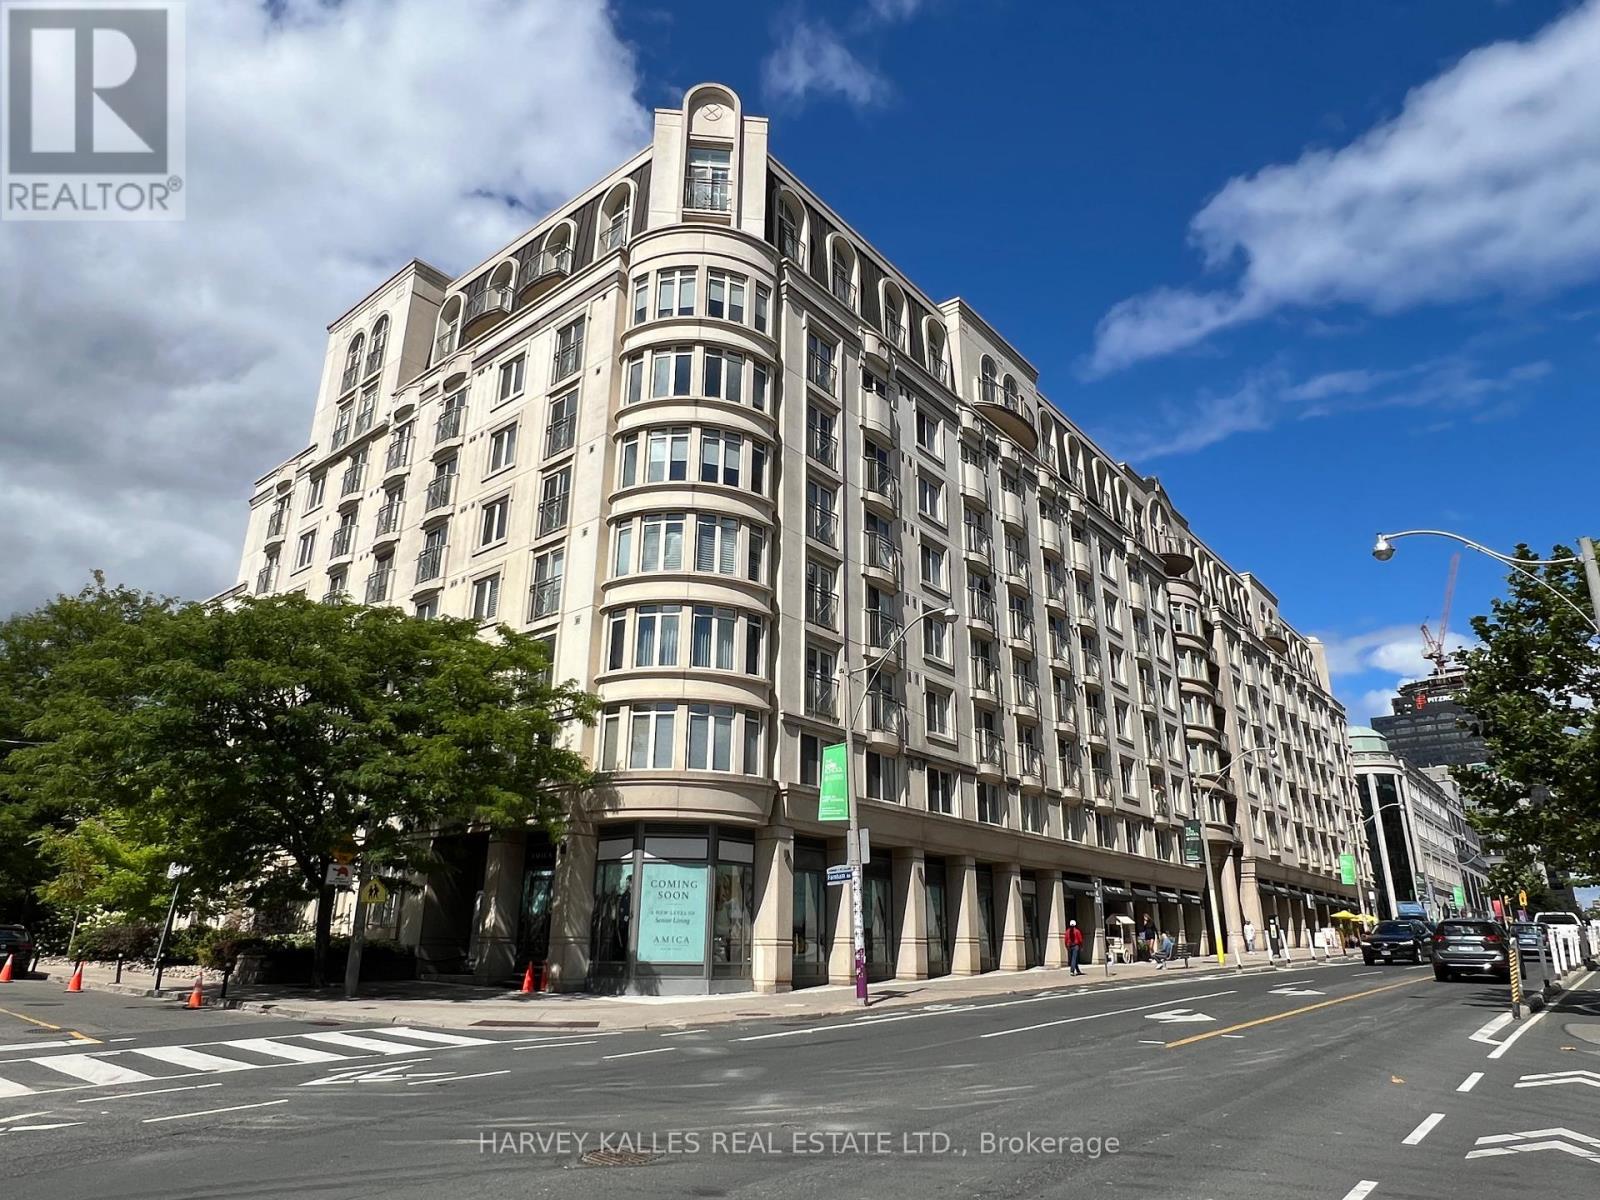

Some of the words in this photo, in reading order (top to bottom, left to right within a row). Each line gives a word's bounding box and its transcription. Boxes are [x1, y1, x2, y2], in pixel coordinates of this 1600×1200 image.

[650, 879, 698, 889] COMING
[658, 890, 689, 900] SOON
[653, 935, 690, 945] AMICA
